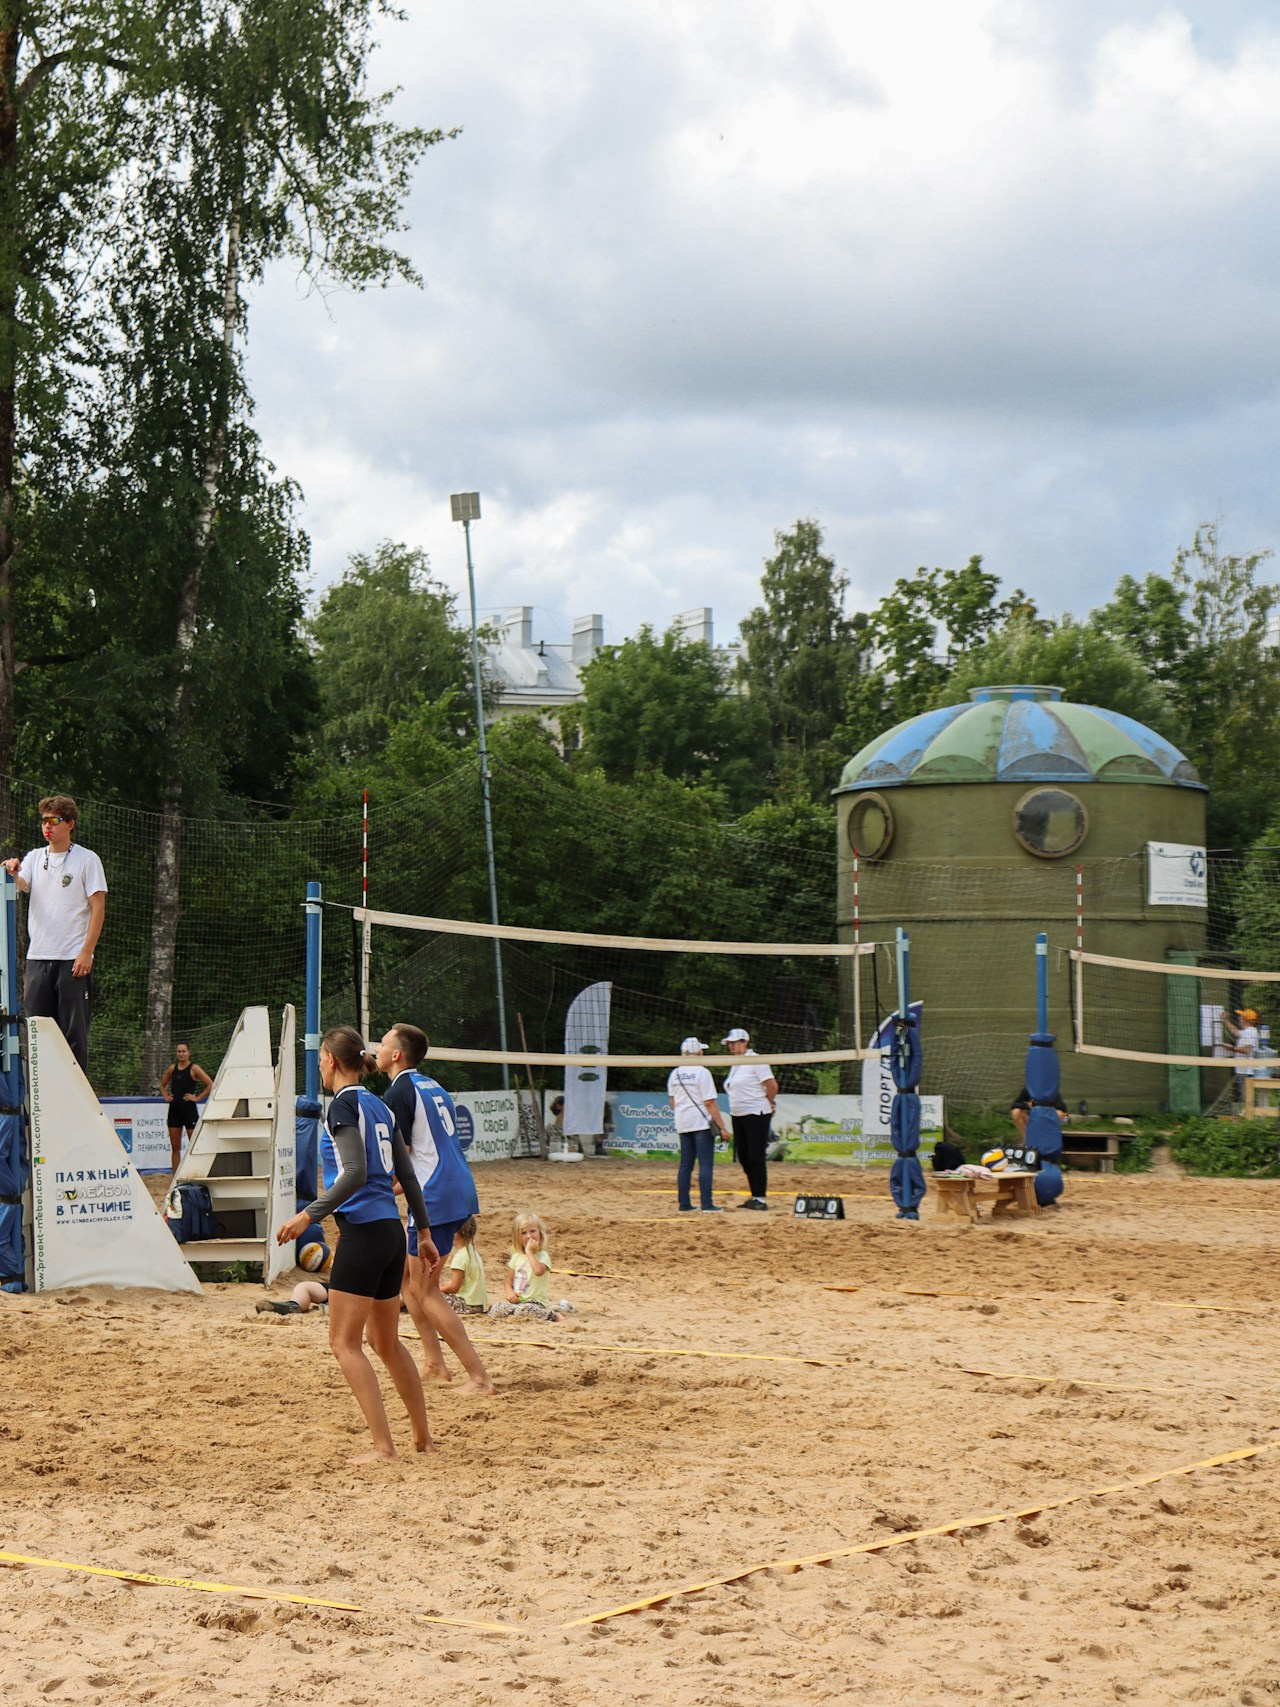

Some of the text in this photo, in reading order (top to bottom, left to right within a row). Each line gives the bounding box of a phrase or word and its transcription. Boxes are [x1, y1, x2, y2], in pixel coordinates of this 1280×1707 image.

[474, 1098, 515, 1116] ПОДЕЛИСЬ
[137, 1118, 164, 1127] КОМИТЕТ
[432, 1095, 455, 1137] 5
[483, 1116, 509, 1133] СВОЕЙ
[137, 1143, 172, 1152] ЛЕНИНГРАД
[375, 1122, 394, 1174] 6
[55, 1165, 129, 1183] ПЛЯЖНЫЙ
[56, 1200, 131, 1216] В ГАТЧИНЕ
[795, 1199, 837, 1214] 0 0
[35, 1168, 46, 1290] ww.proekt-mebel.com
